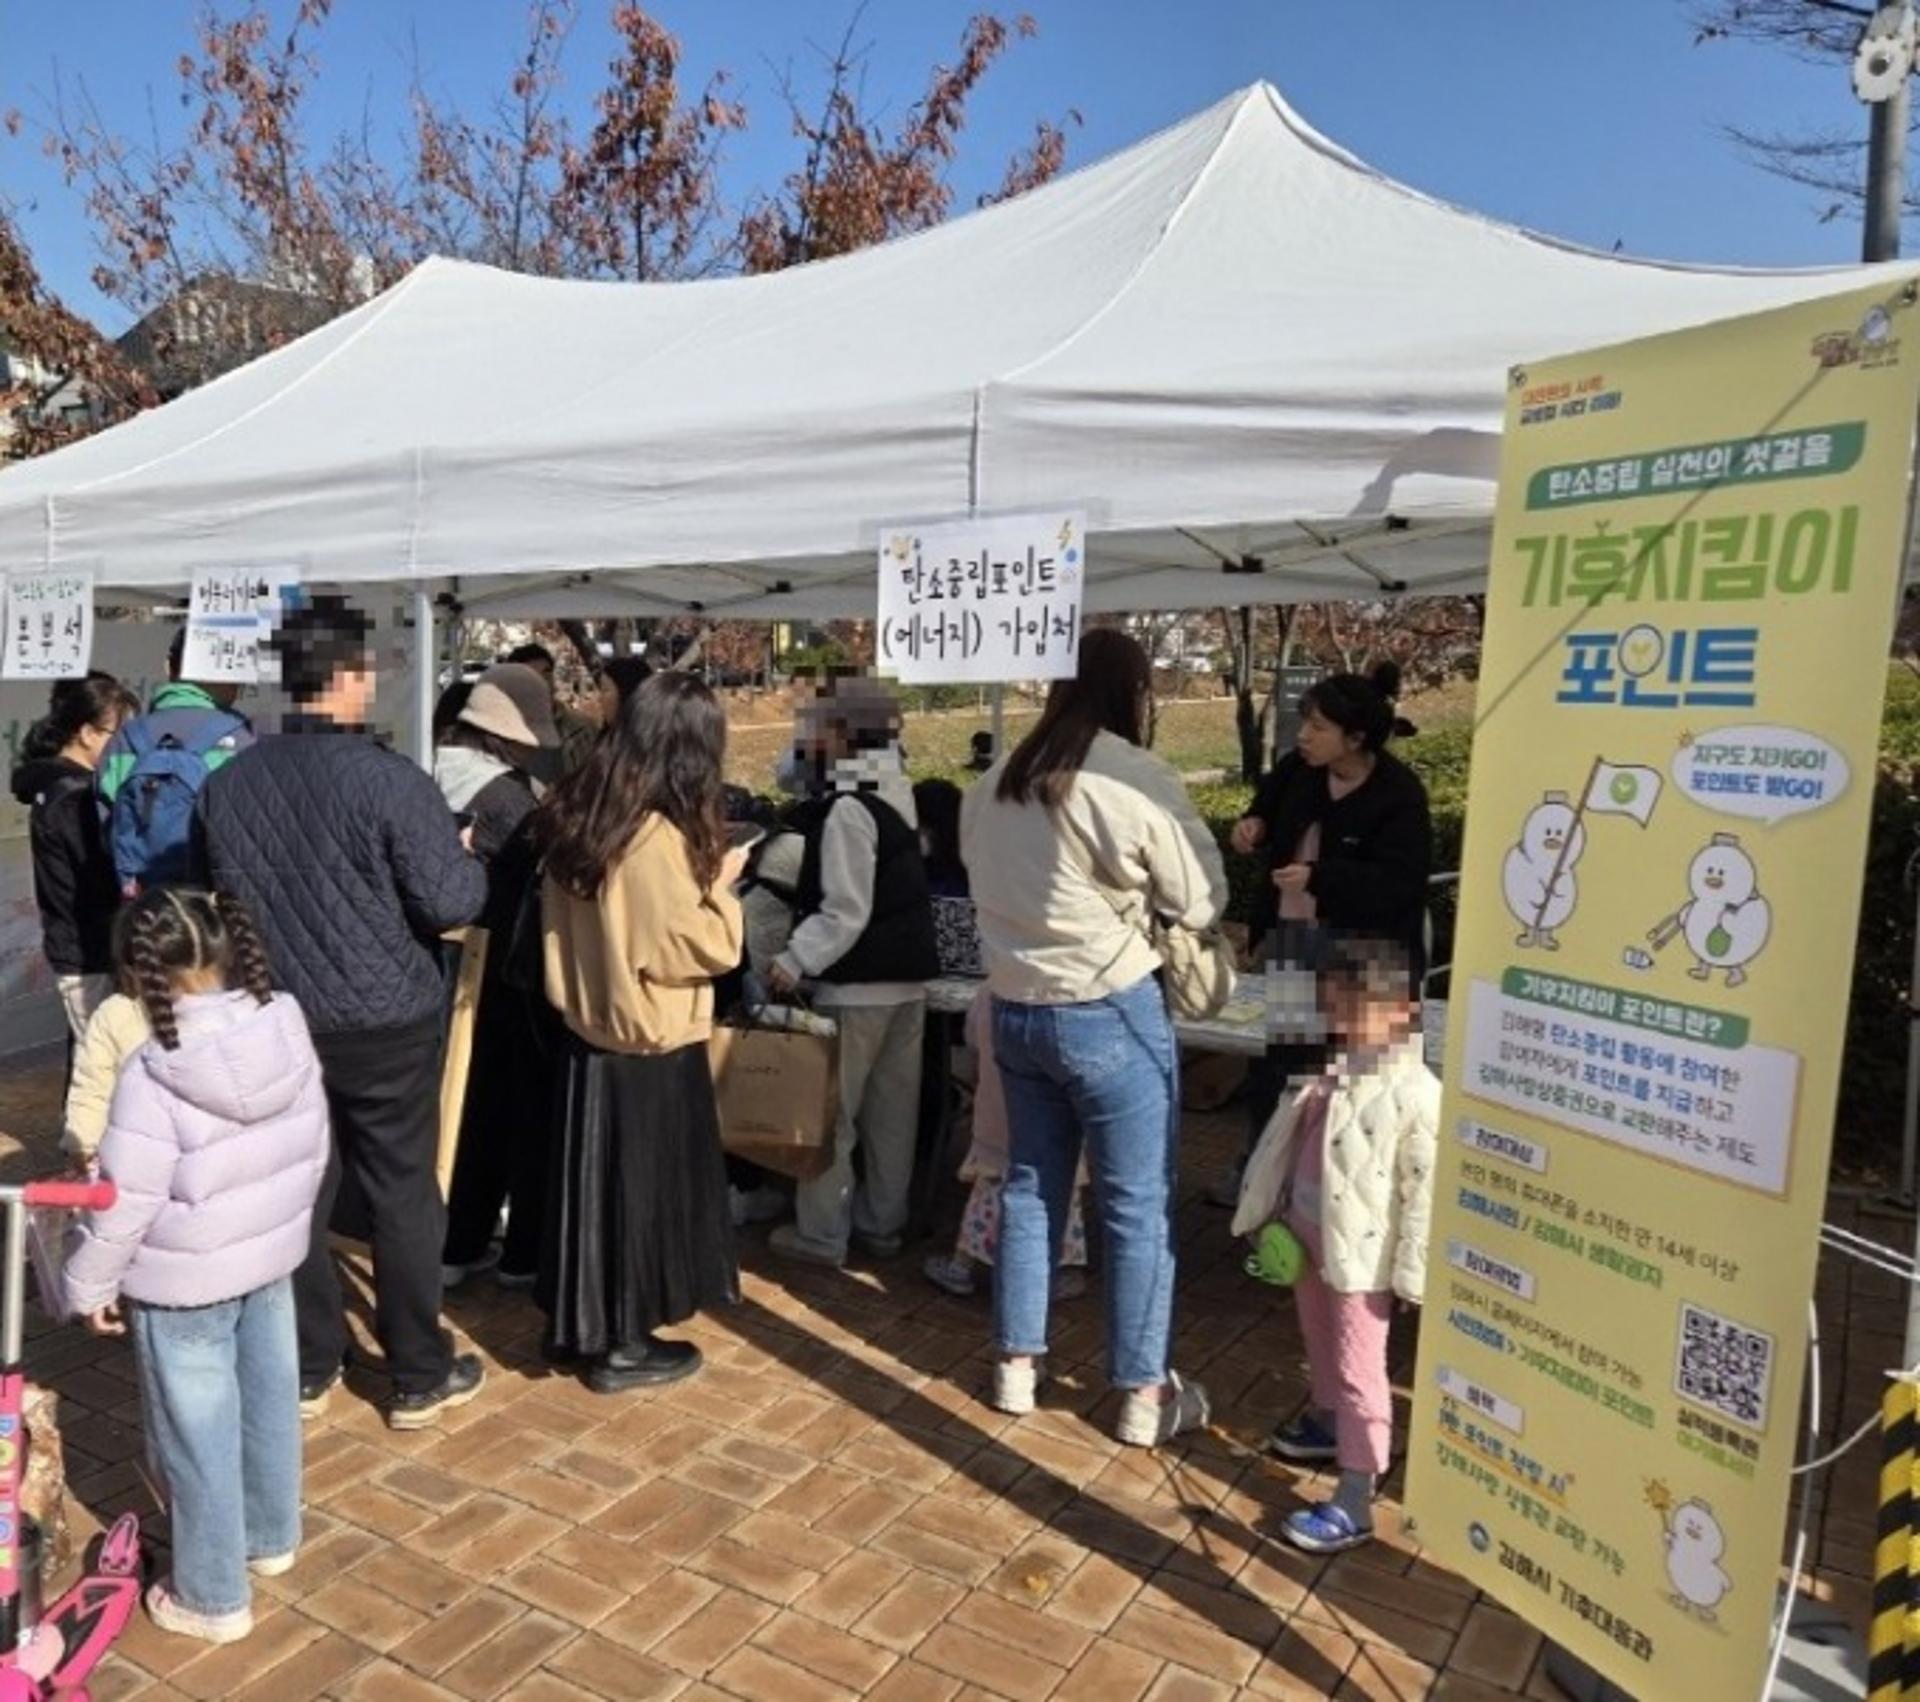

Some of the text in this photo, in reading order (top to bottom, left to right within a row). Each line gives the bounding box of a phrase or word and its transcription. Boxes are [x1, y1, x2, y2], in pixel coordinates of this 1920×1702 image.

[1549, 432, 1833, 500] 탄소중립 실천의 첫걸음
[901, 546, 1055, 603] 탄소중립포인트
[1515, 505, 1860, 608] 기후지킴이
[883, 604, 1076, 660] (에너지) 가입처
[1556, 623, 1760, 708] 포인트
[1691, 770, 1824, 800] 포인트도 받GO!
[1693, 744, 1828, 771] 지구도 지키GO!
[1521, 974, 1723, 1038] 기후지킴이 포인트란?
[1550, 1024, 1616, 1059] 탄소중립
[1680, 1057, 1741, 1093] 참여한
[1583, 1062, 1650, 1102] 포인트를
[1656, 1083, 1734, 1123] 지급하고
[1715, 1134, 1758, 1167] 제도
[1657, 1235, 1696, 1268] 14세
[1699, 1251, 1741, 1283] 이상
[1498, 1540, 1552, 1594] 김해시
